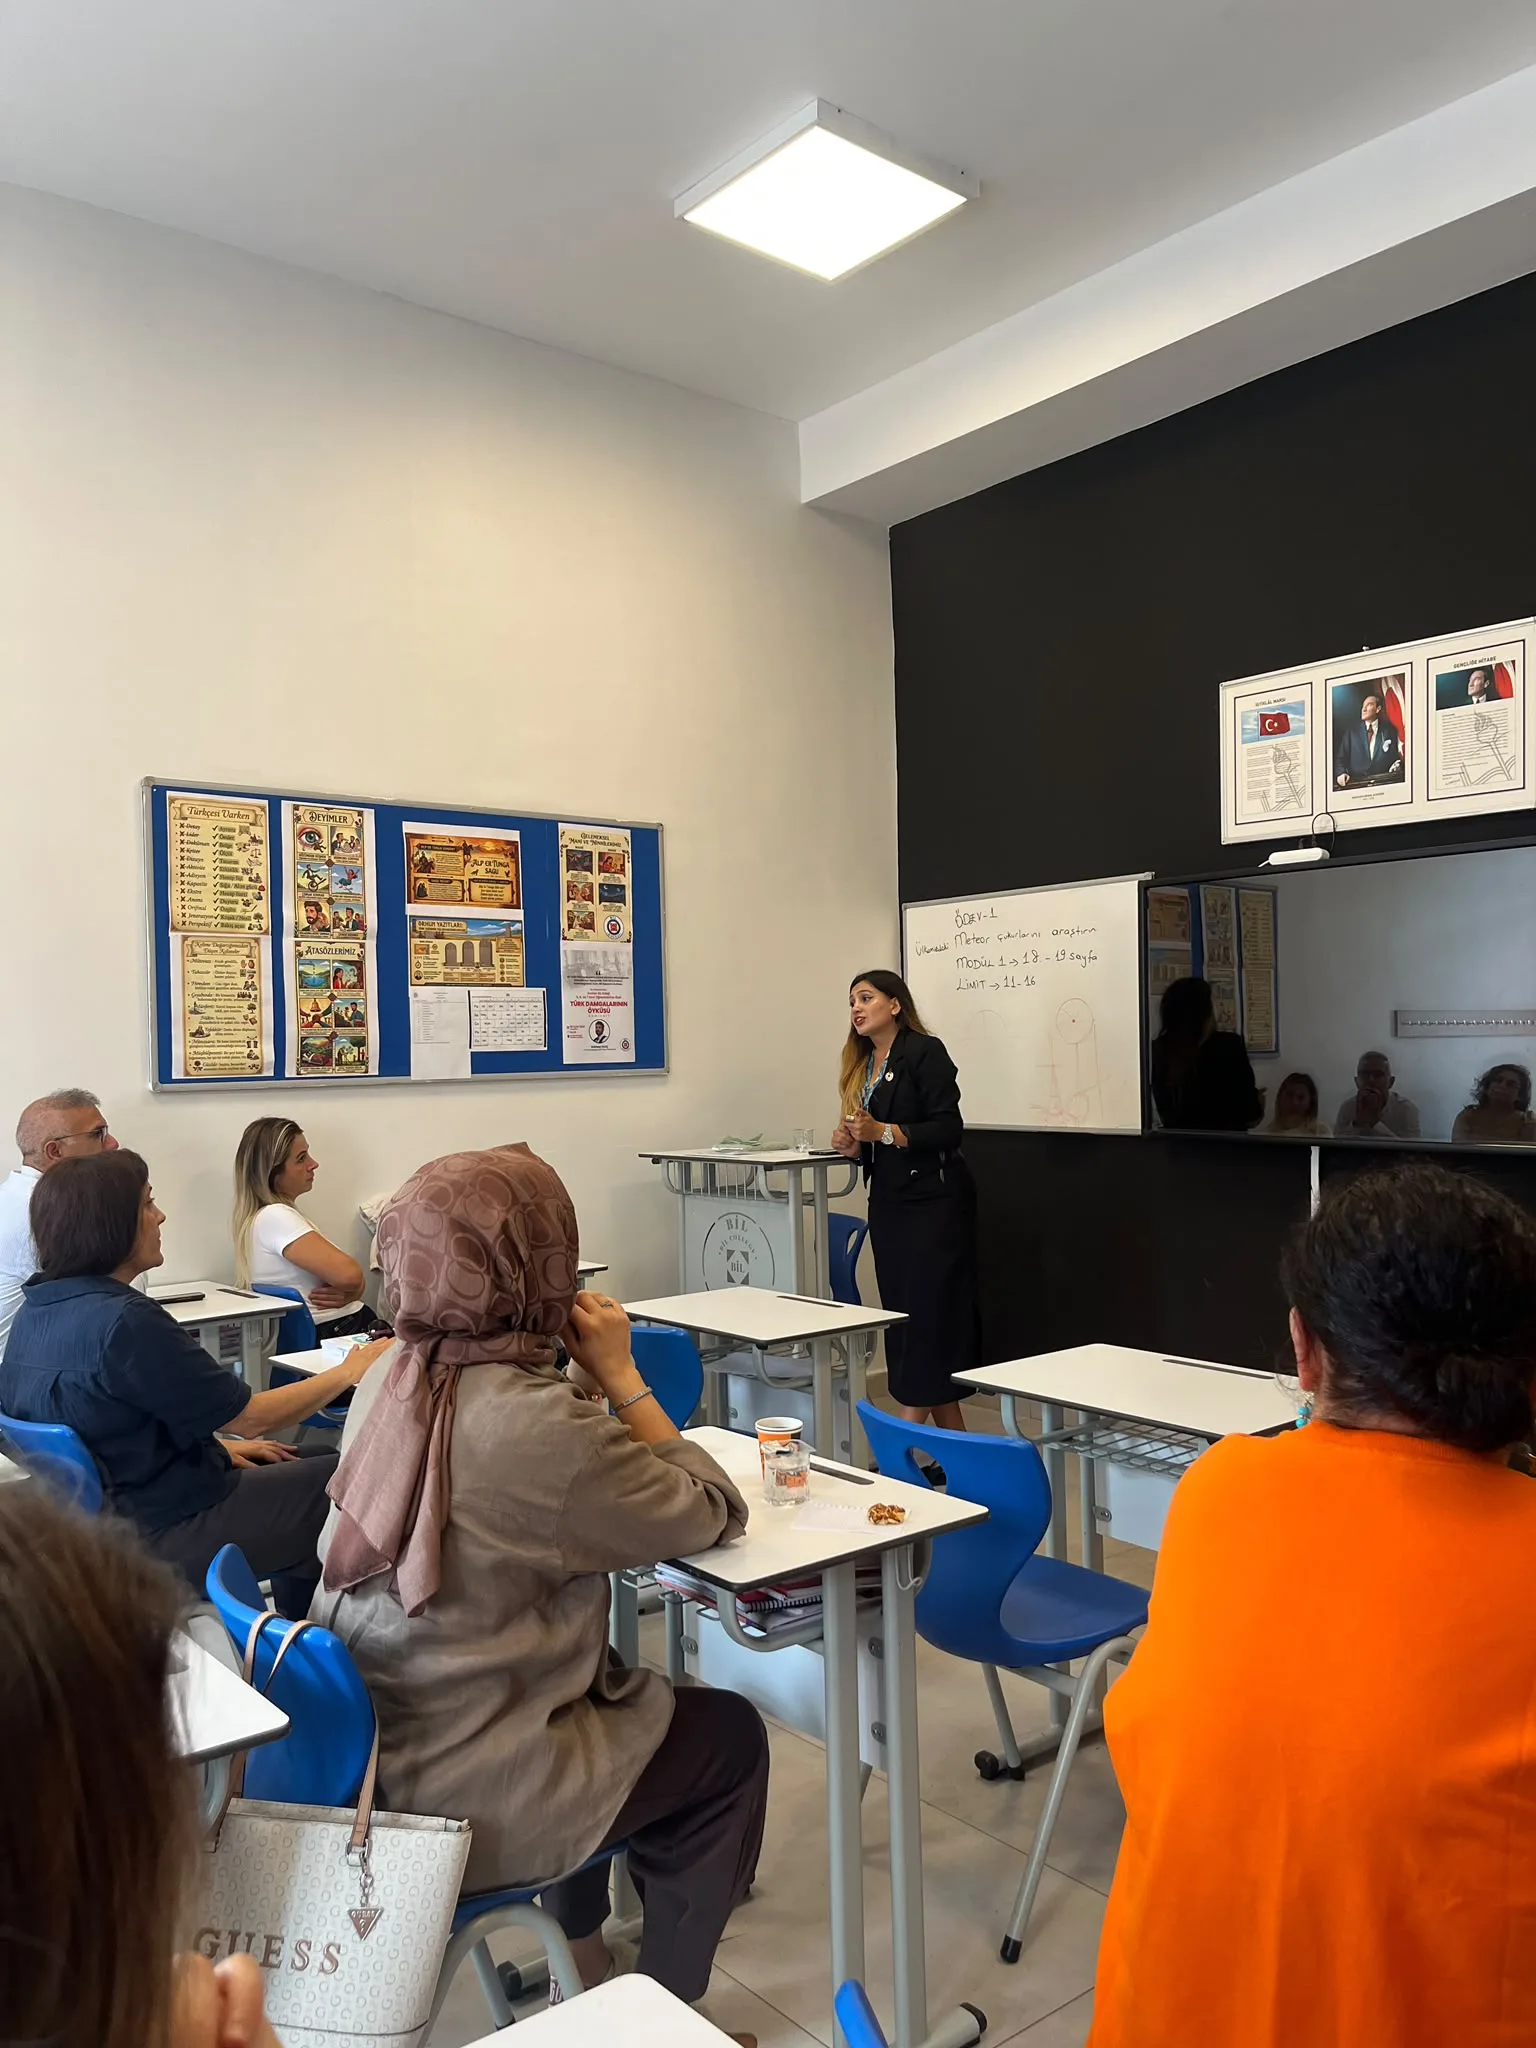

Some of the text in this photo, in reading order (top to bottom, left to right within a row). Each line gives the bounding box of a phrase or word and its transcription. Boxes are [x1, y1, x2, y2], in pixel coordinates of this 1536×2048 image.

[187, 806, 250, 820] Türkçesi Varken
[309, 811, 348, 824] DEYİMLER
[954, 931, 990, 948] Meteor
[305, 945, 356, 956] ATASÖZLERİMİZ
[956, 955, 995, 969] MODÜL
[998, 955, 1006, 967] 1
[1069, 949, 1098, 968] sayfa
[726, 1215, 748, 1232] BİL
[731, 1260, 745, 1273] BİL
[193, 1926, 342, 1975] GUESS
